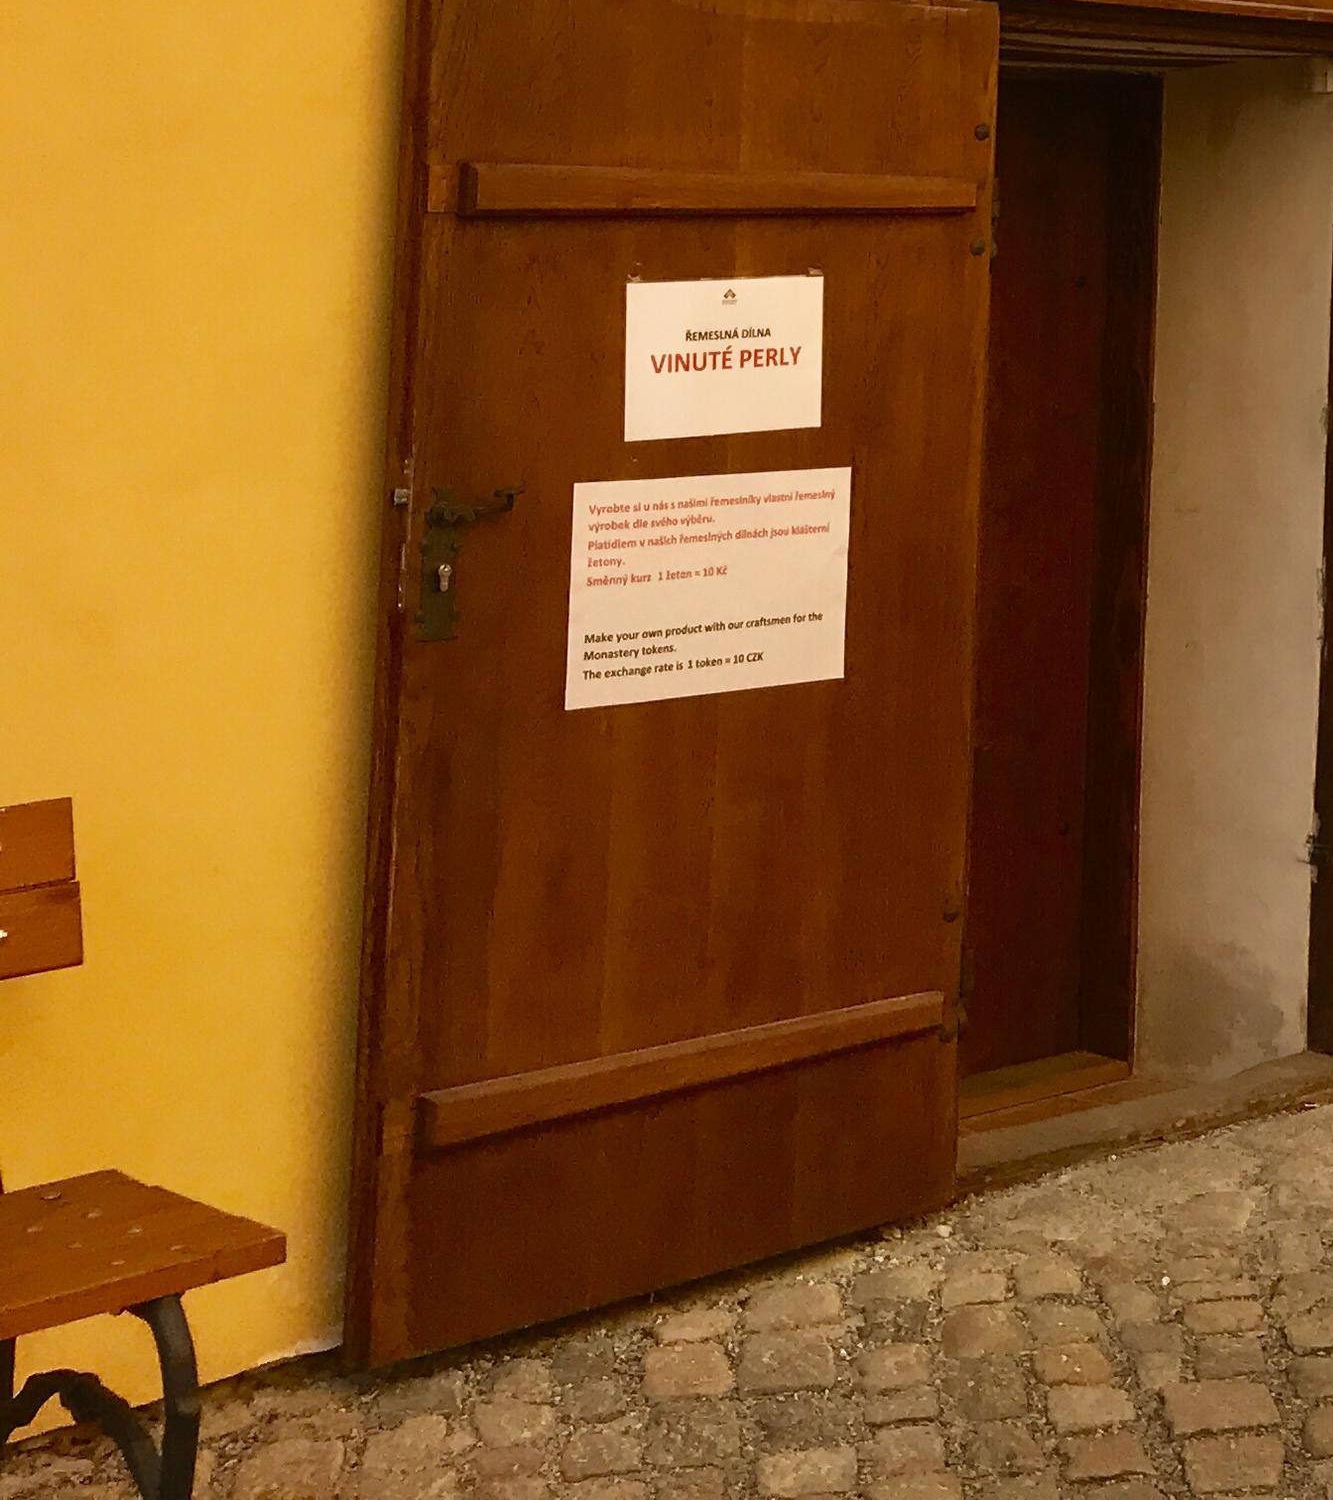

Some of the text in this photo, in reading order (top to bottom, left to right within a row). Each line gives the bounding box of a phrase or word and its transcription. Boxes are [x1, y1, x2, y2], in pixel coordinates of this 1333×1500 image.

[685, 326, 771, 342] ŘEMESLNÁ DÍLNA
[650, 345, 802, 374] VINUTÉ PERLY
[589, 503, 630, 516] Vyrobte
[633, 502, 641, 512] si
[643, 503, 650, 511] u
[652, 500, 668, 511] nás
[588, 519, 630, 533] výrobek
[632, 519, 648, 529] dle
[651, 517, 678, 527] svého
[588, 538, 637, 550] Platidlem
[640, 539, 645, 547] v
[770, 527, 789, 539] jsou
[586, 574, 629, 587] Směnný
[630, 573, 652, 583] kurz
[658, 571, 663, 581] 1
[665, 569, 692, 580] žeton
[703, 567, 714, 577] 10
[716, 565, 728, 576] Kč
[584, 611, 823, 644] Make your own product with our craftsmen for the
[584, 644, 677, 660] Monastery tokens.
[582, 669, 602, 680] The
[604, 665, 652, 678] exchange
[654, 663, 674, 673] rate
[676, 660, 684, 670] is
[687, 659, 693, 669] 1
[695, 657, 723, 668] token
[733, 653, 744, 664] 10
[746, 651, 764, 663] CZK
